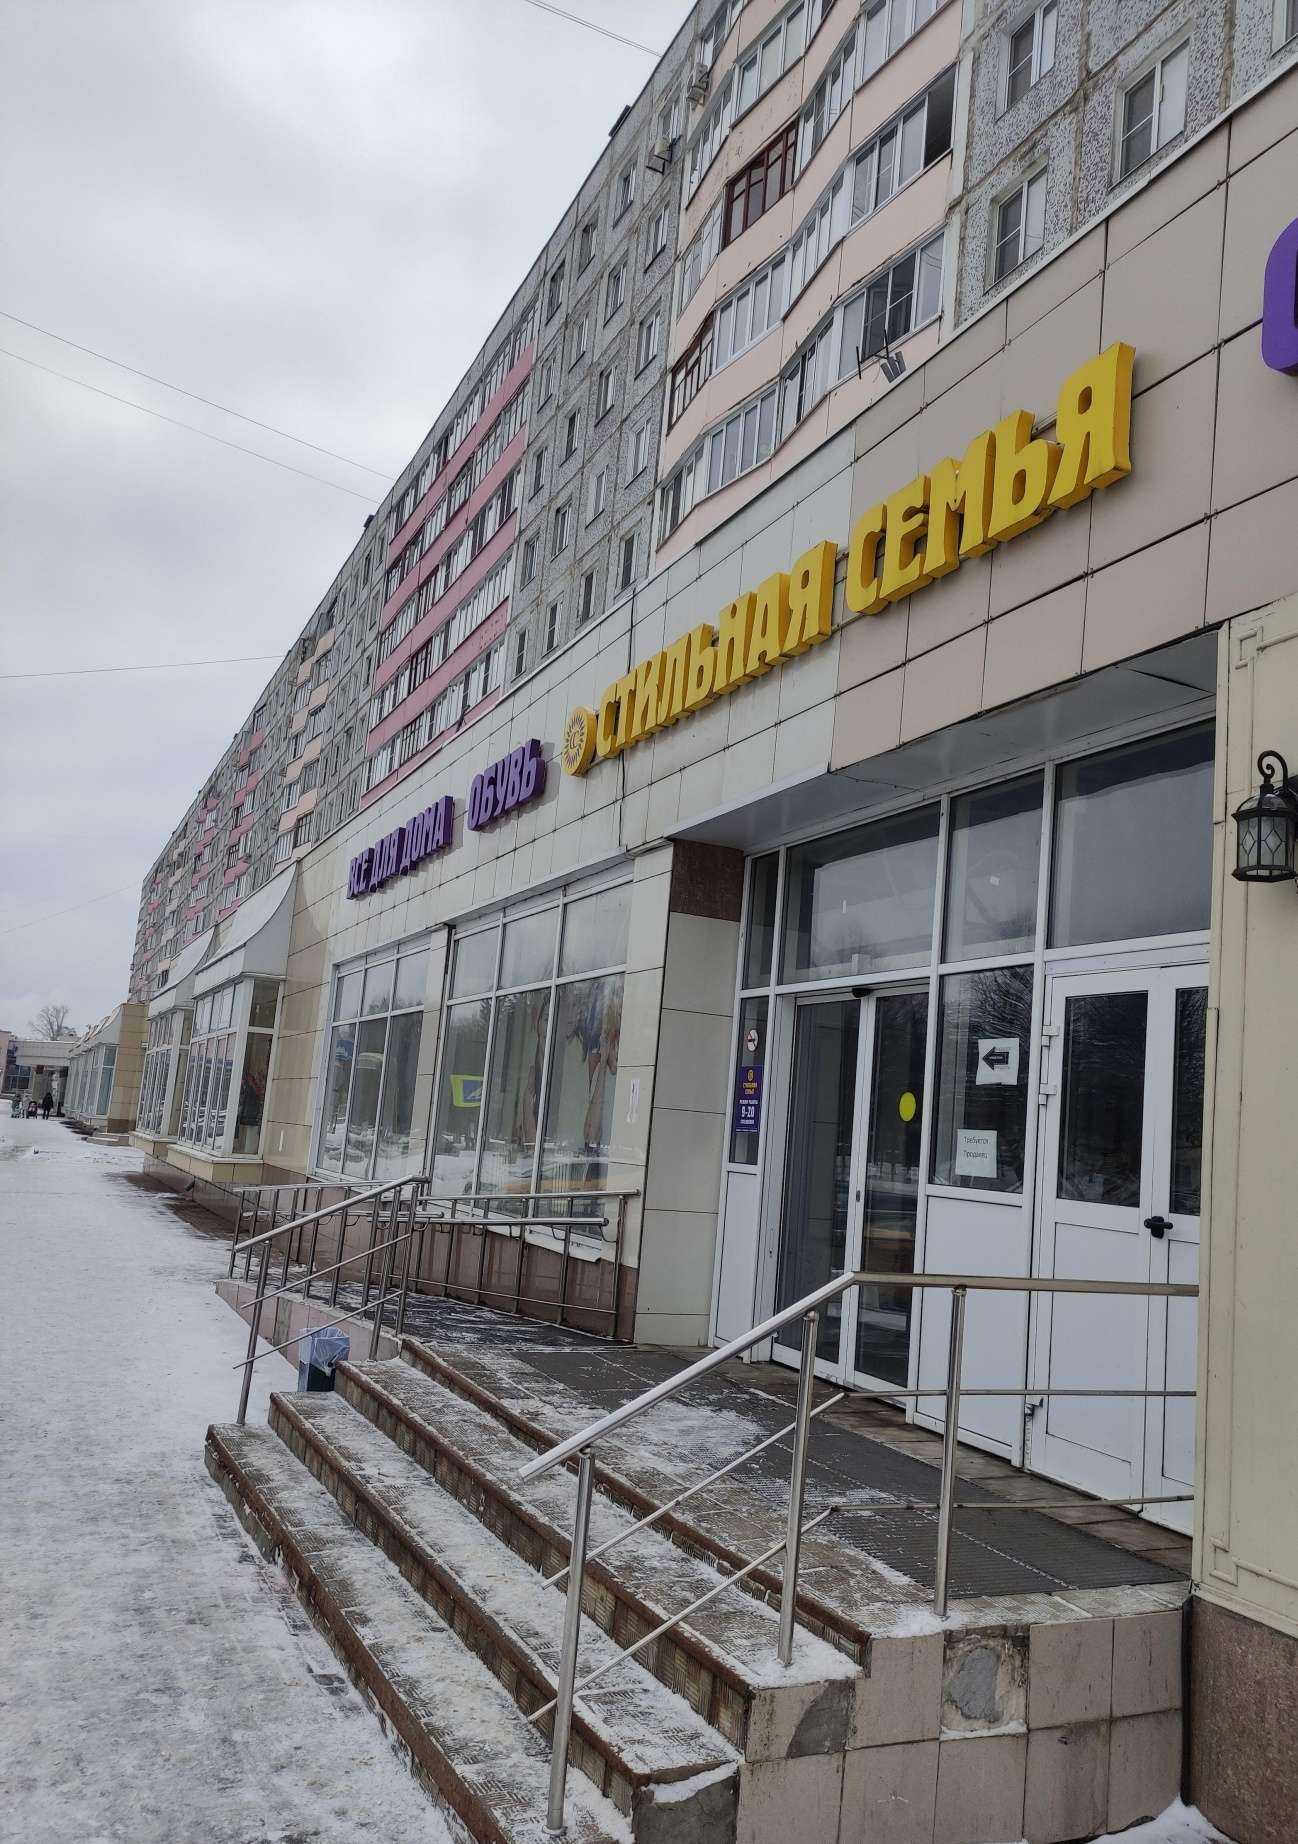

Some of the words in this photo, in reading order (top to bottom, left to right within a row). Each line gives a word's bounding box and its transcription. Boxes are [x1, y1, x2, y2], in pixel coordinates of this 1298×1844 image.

[596, 540, 838, 759] СТИЛЬНАЯ
[846, 342, 1136, 614] СЕМЬЯ
[467, 738, 546, 831] ОБУВЬ
[346, 848, 374, 900] ВСЕ
[370, 827, 406, 892] ДЛЯ
[401, 796, 454, 876] ДОМА
